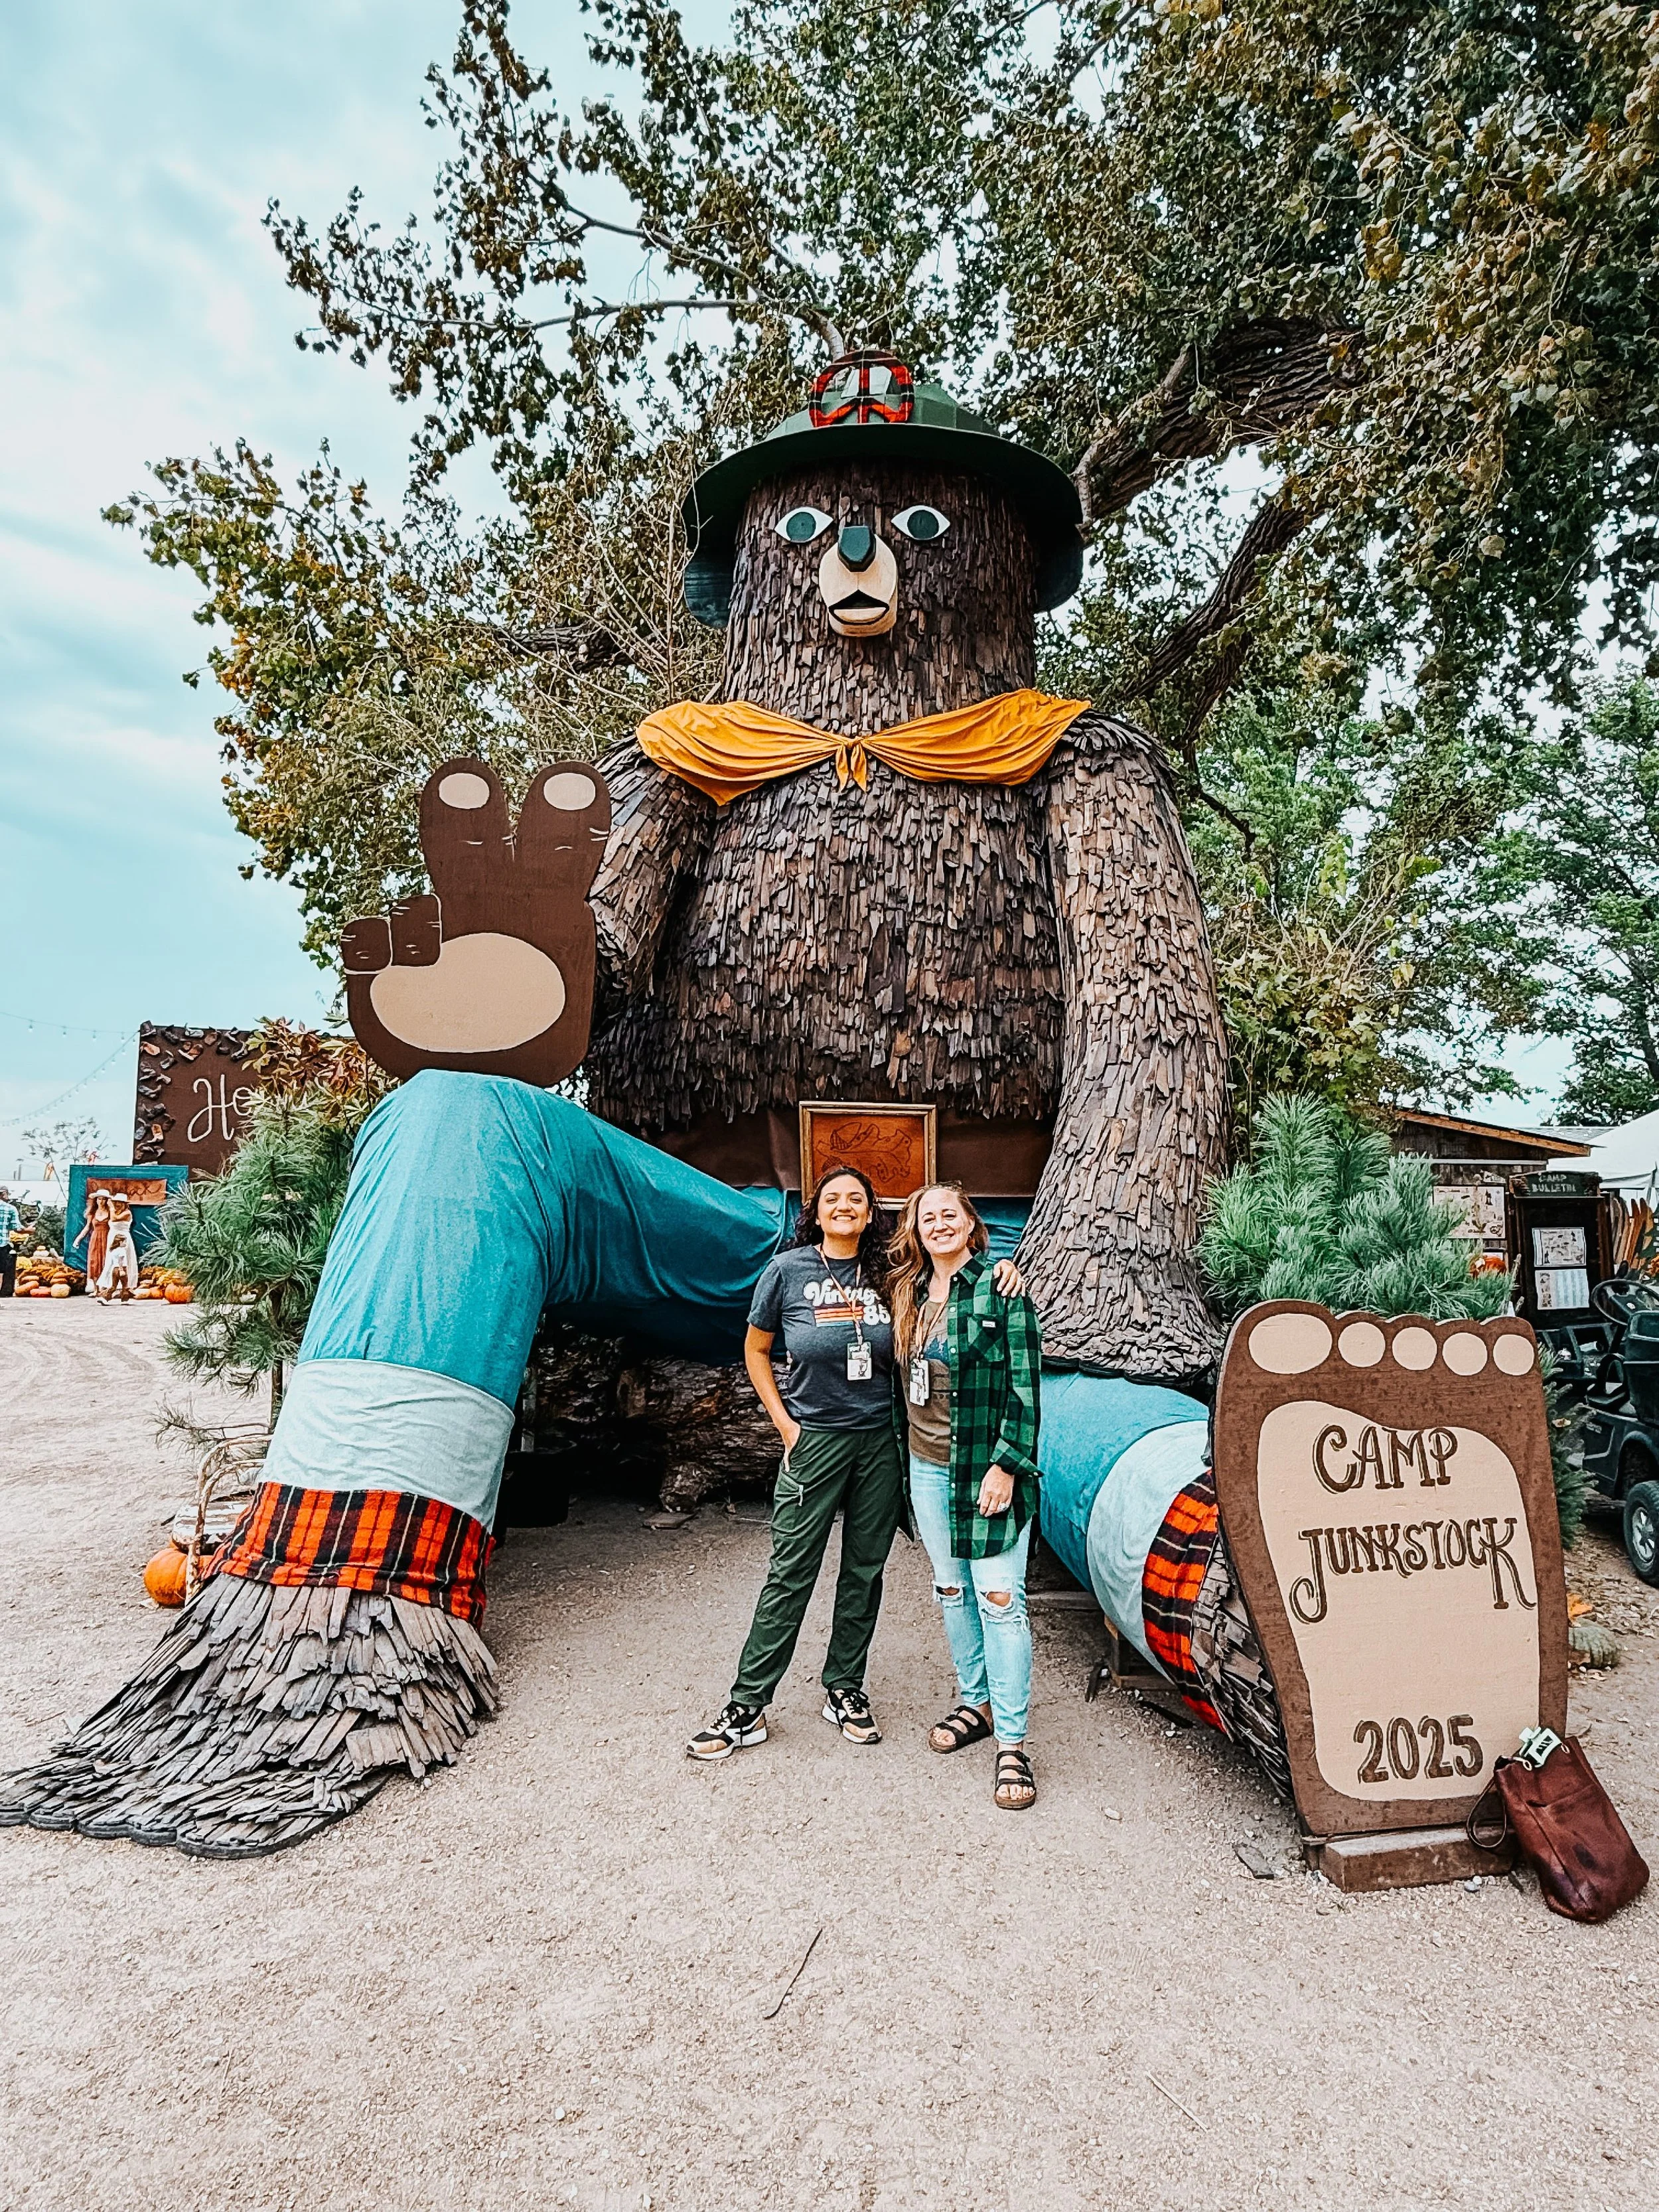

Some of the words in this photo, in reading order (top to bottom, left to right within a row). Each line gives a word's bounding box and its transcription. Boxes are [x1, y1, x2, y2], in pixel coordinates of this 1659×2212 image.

[1539, 1174, 1567, 1183] CAMP
[863, 1303, 891, 1325] 85
[1312, 1424, 1458, 1494] CAMP
[1289, 1516, 1537, 1625] JUNKSTOCK
[1353, 1714, 1483, 1784] 2025
